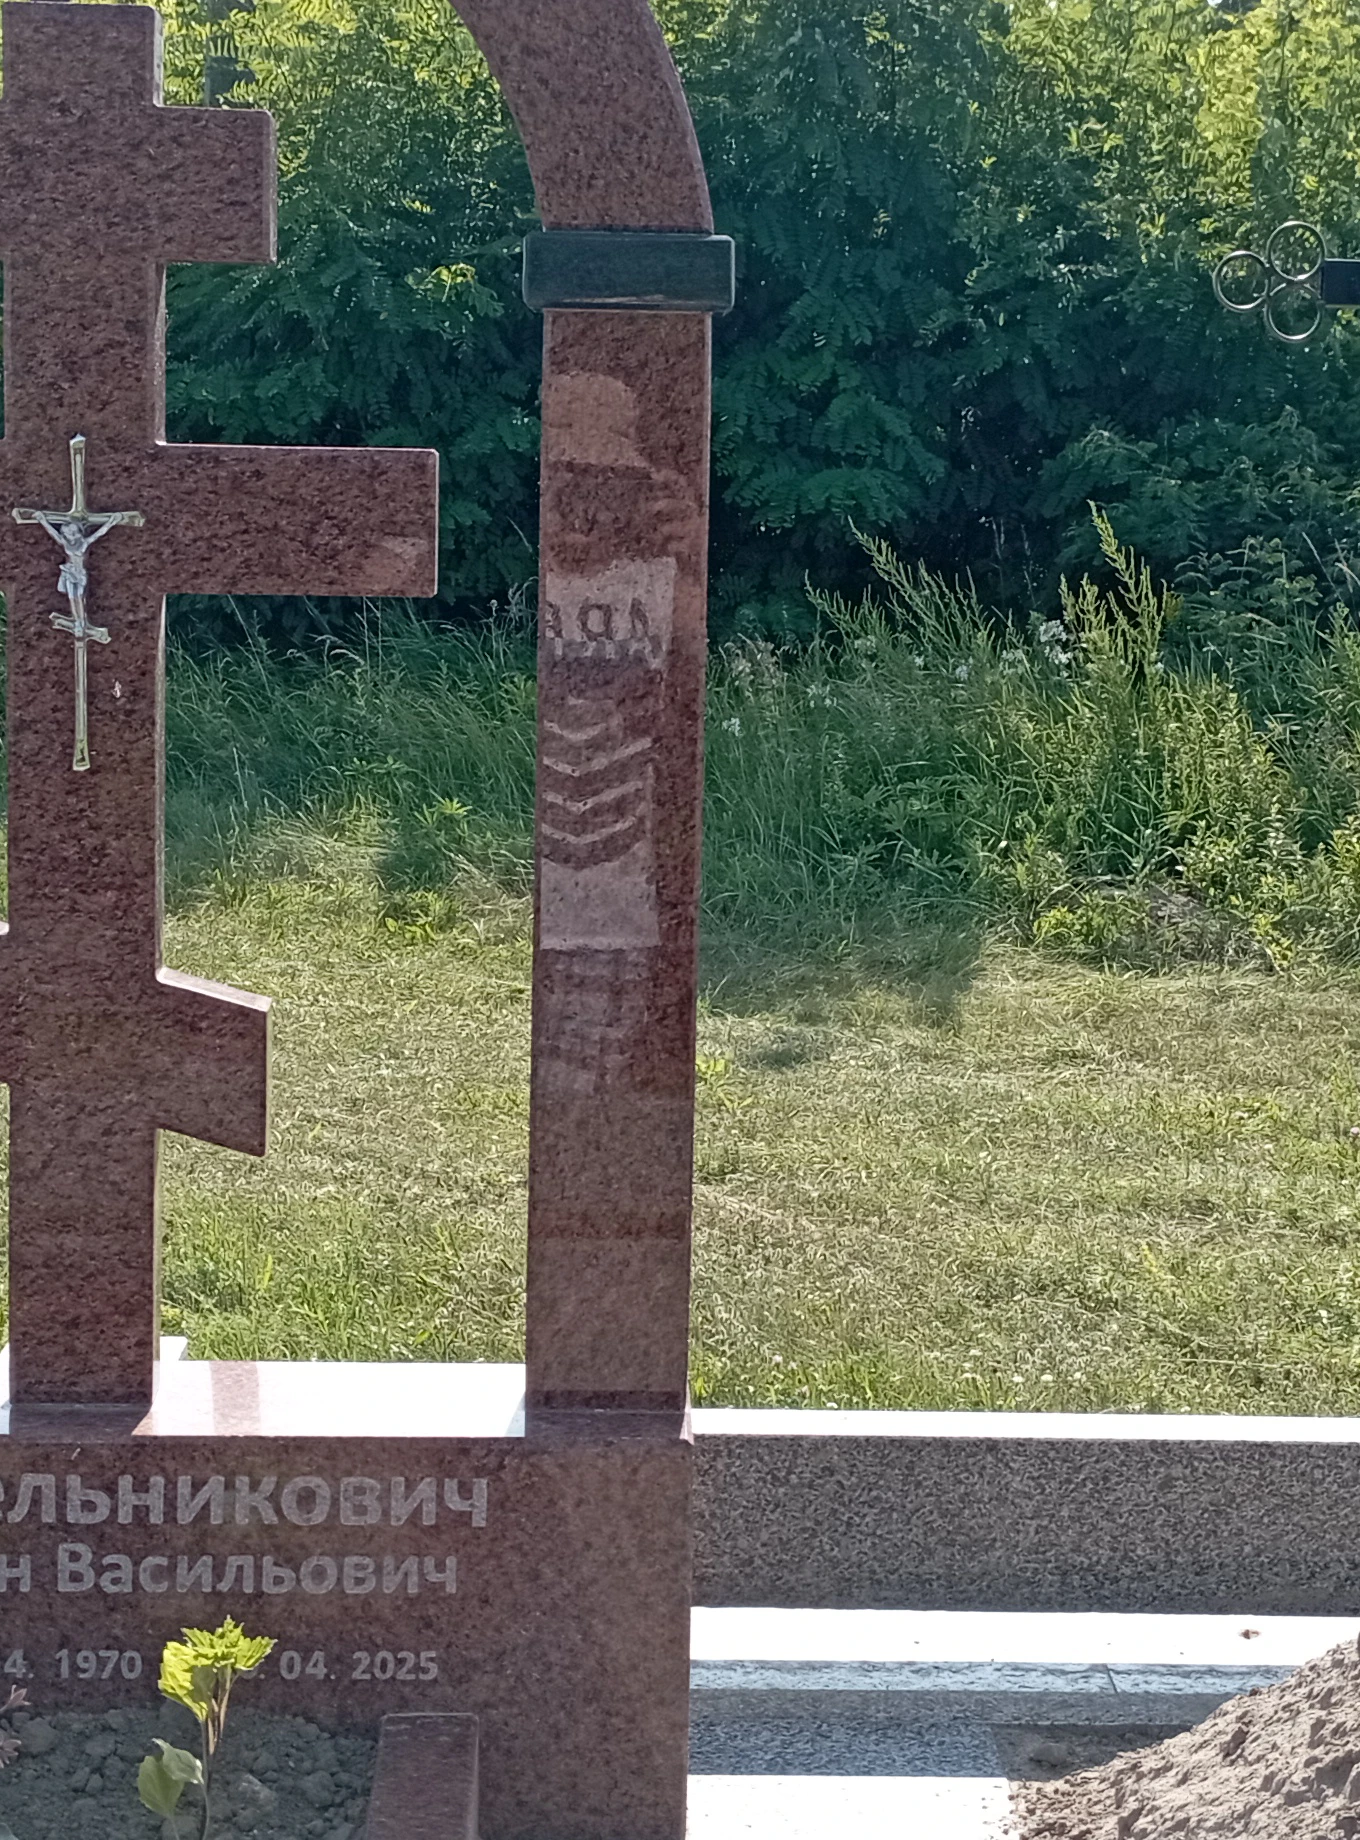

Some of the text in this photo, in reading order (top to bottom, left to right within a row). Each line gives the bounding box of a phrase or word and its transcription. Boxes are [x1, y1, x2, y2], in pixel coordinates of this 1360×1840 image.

[56, 1542, 458, 1594] Васильович
[55, 1648, 142, 1681] 1970
[279, 1650, 336, 1681] 04.
[351, 1650, 439, 1682] 2025
